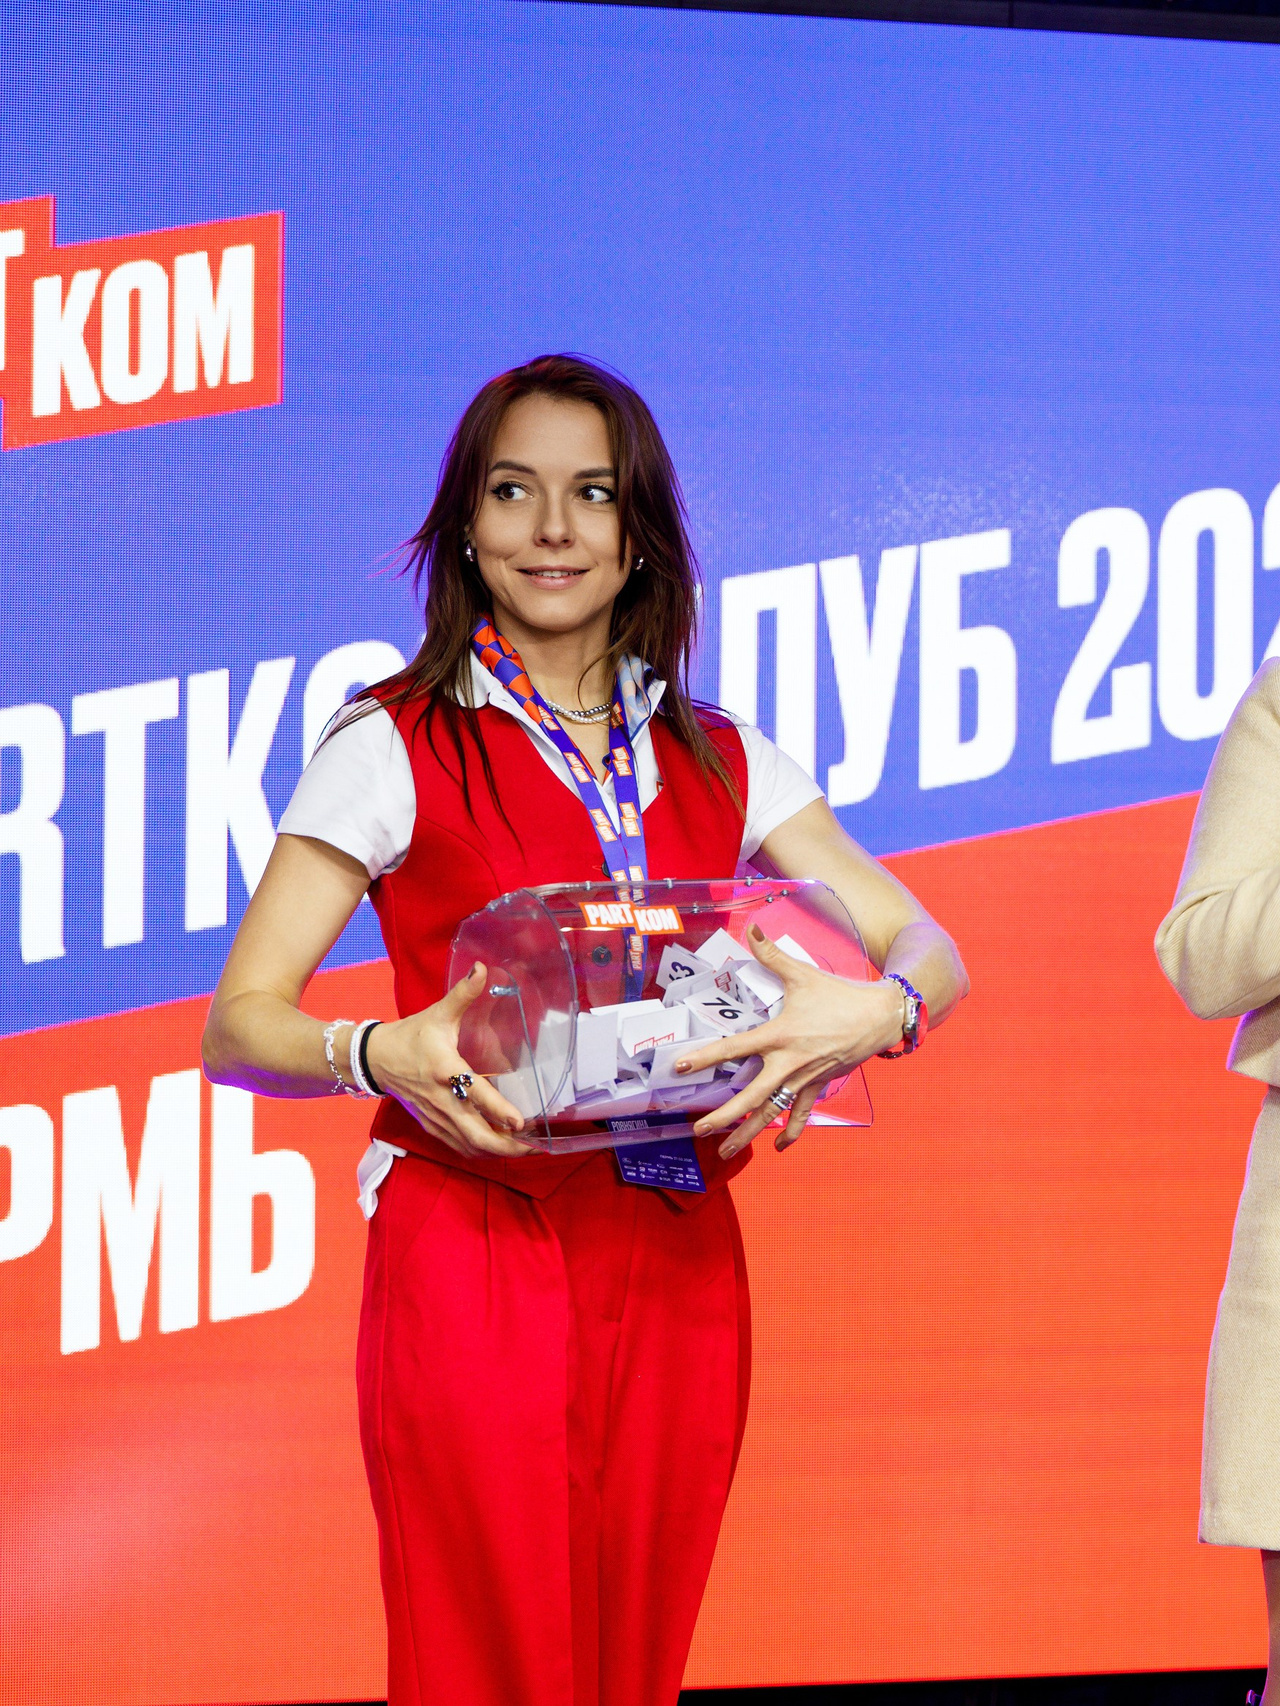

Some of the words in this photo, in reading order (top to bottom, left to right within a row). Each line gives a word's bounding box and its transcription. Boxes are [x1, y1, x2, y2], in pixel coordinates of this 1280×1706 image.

[32, 243, 255, 417] KOM
[0, 641, 407, 965] RTK
[717, 527, 1018, 808] ЛУБ
[584, 903, 634, 926] PART
[633, 908, 680, 932] KOM
[632, 936, 642, 951] KOM
[631, 952, 641, 969] PART
[702, 997, 745, 1020] 76
